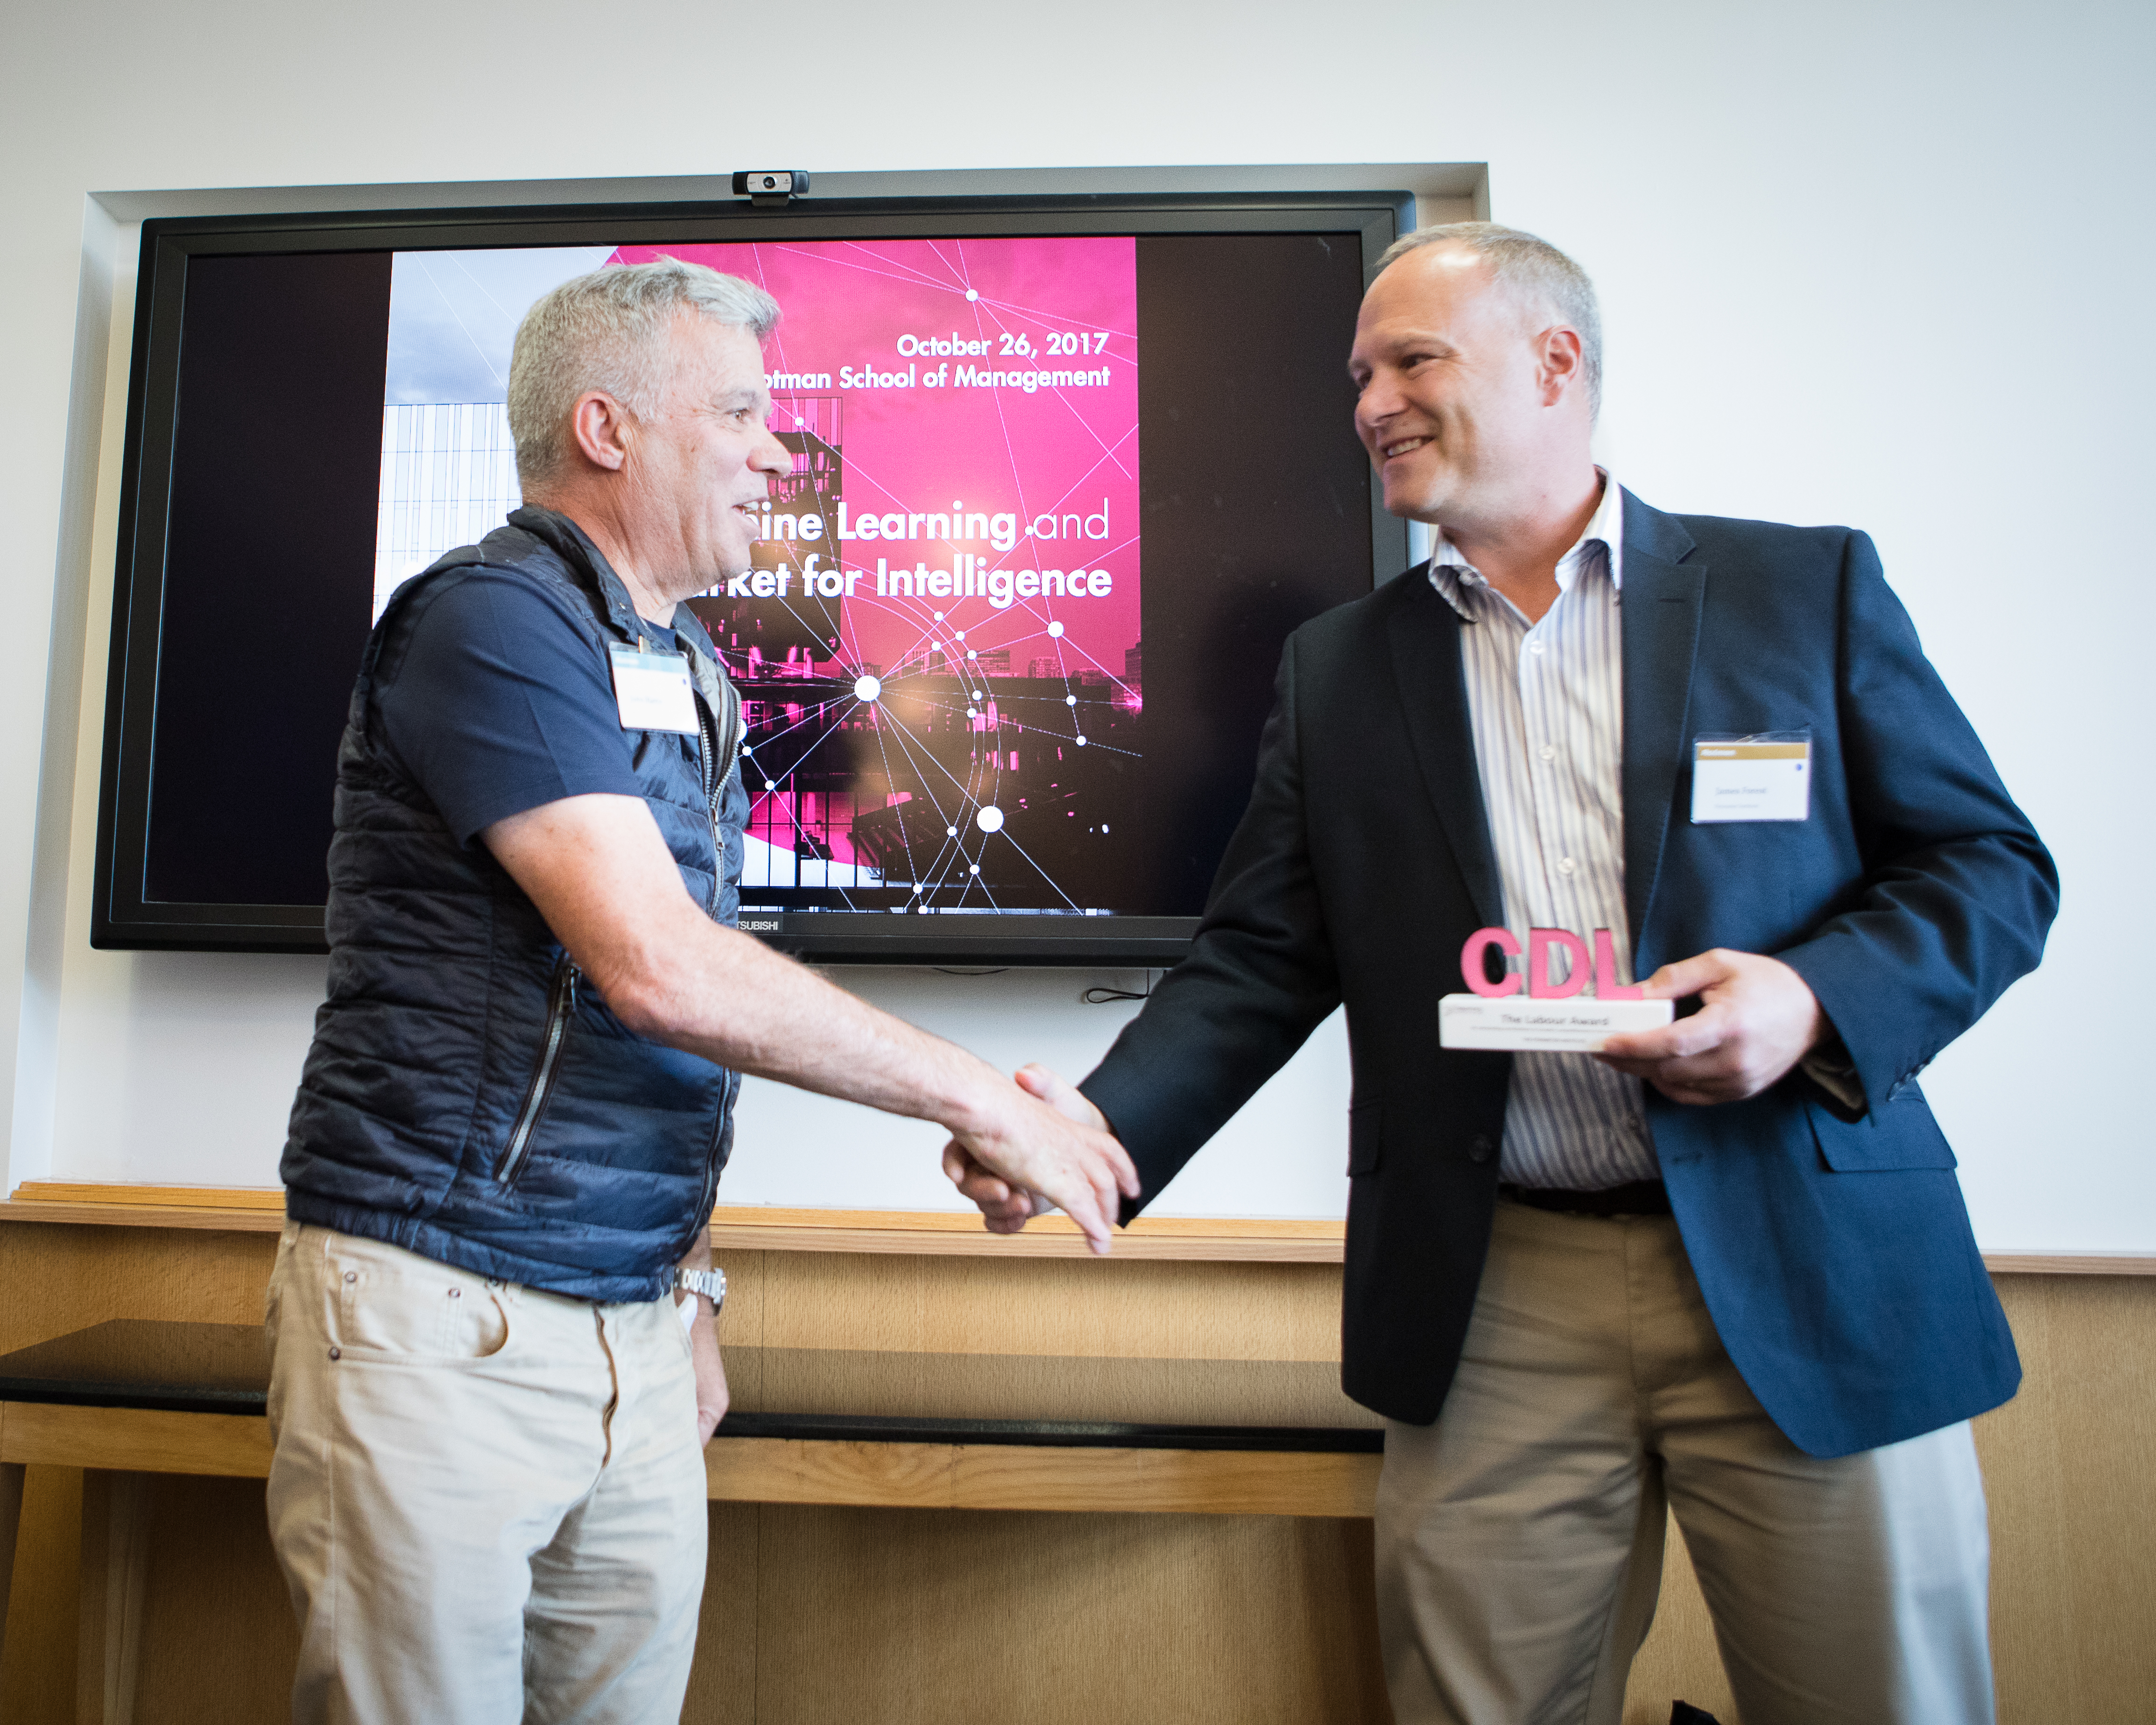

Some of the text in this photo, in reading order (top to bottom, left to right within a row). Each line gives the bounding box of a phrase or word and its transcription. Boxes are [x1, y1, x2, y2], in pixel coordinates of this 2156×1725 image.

[897, 332, 1109, 360] October 26, 2017
[839, 363, 915, 389] School
[923, 363, 948, 388] of
[953, 365, 1110, 393] Management
[838, 501, 1016, 552] Learning
[1033, 497, 1108, 540] and
[802, 553, 862, 597] for
[877, 553, 1112, 609] Intelligence
[1460, 926, 1644, 1000] CDL
[1501, 1014, 1610, 1026] The Labour Award
